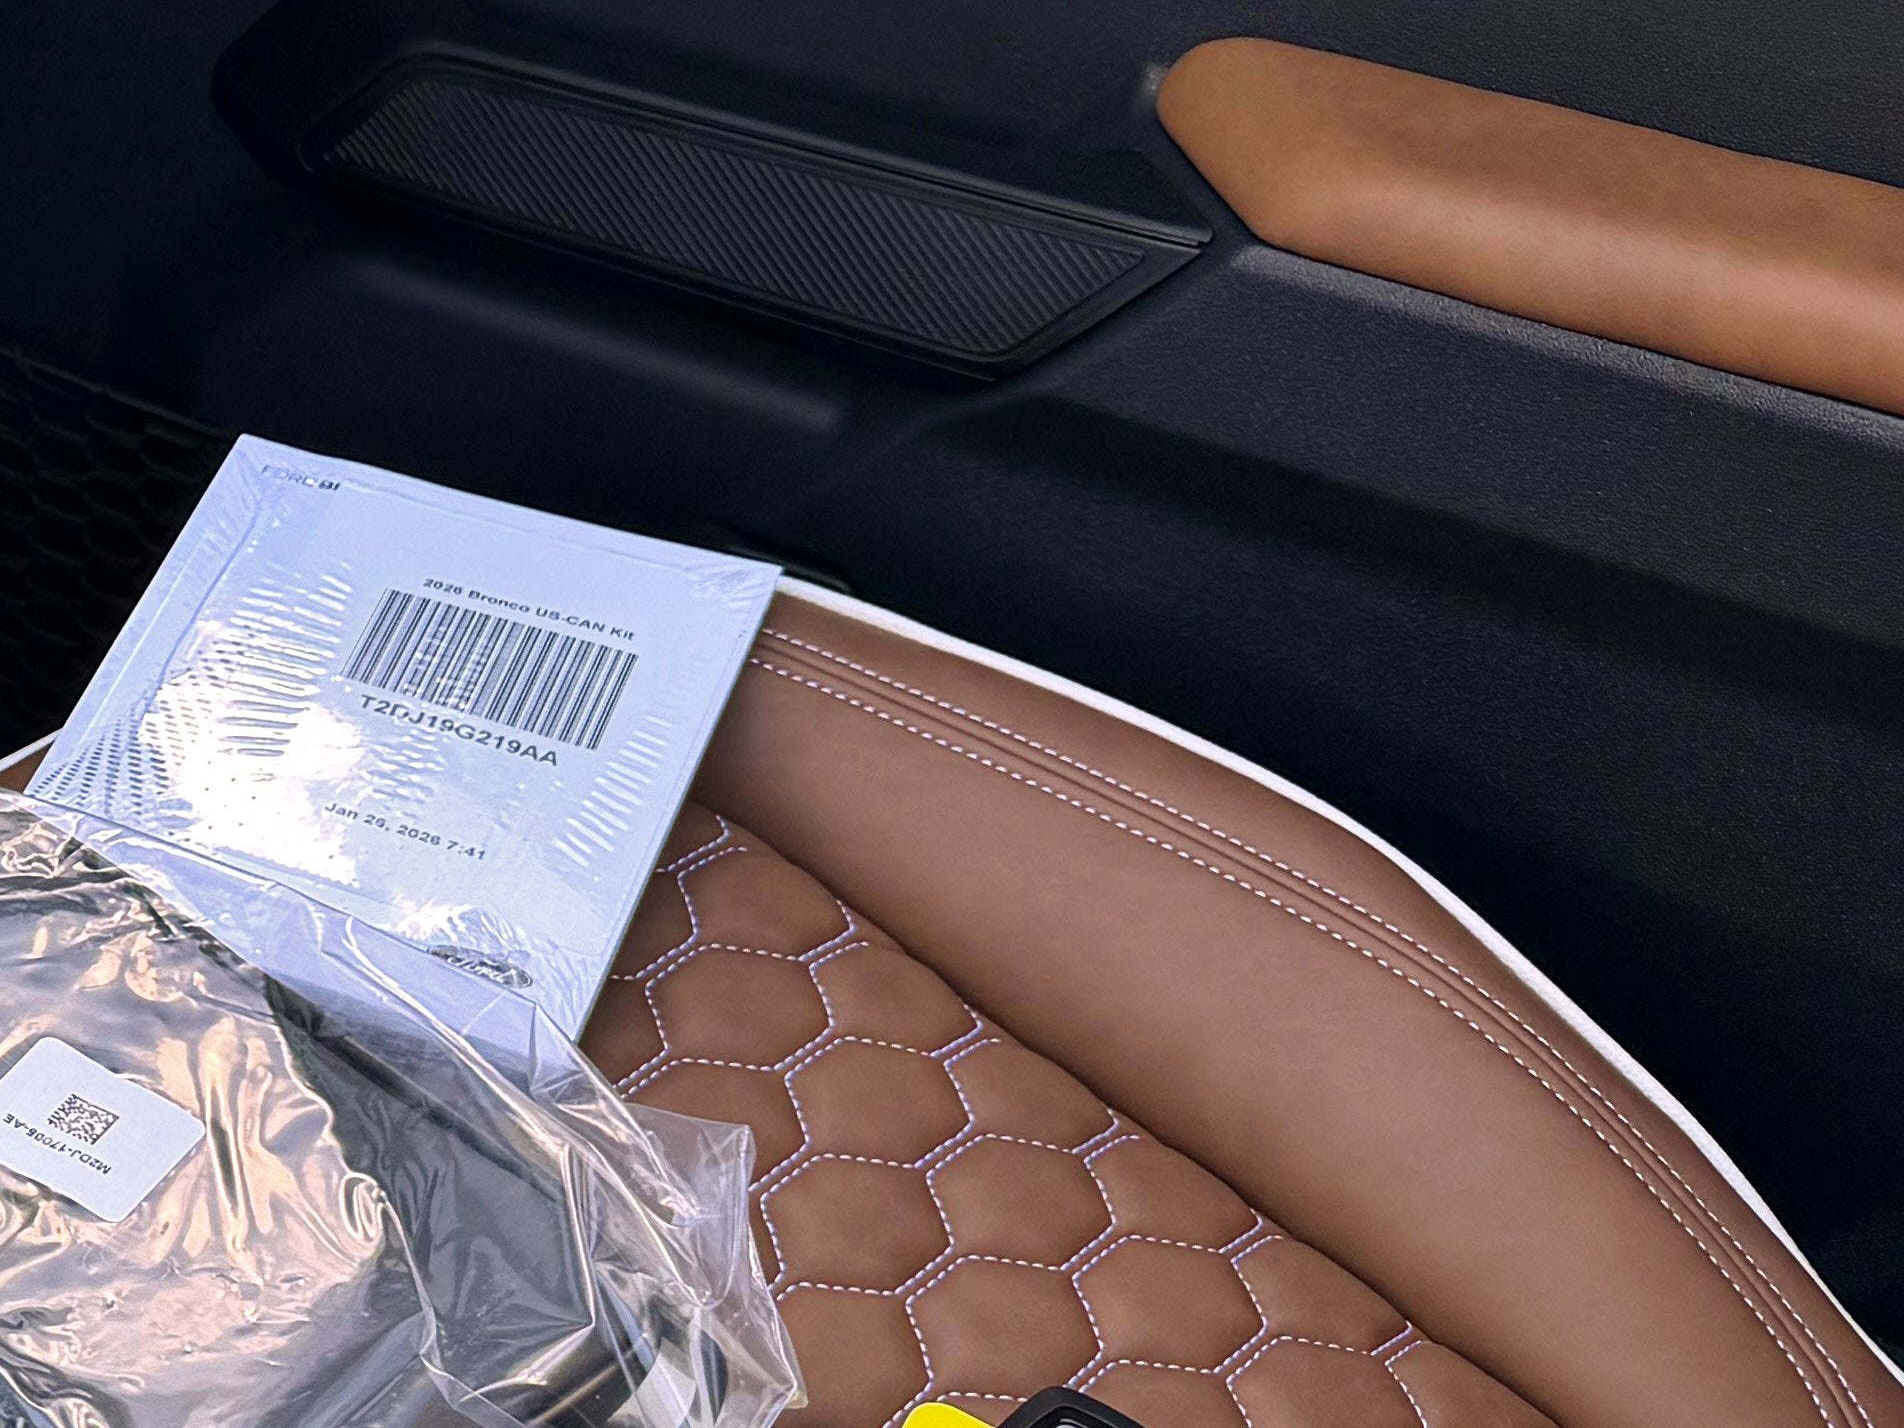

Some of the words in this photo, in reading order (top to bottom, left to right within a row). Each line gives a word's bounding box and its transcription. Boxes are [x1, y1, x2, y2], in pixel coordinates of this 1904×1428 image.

[468, 588, 530, 613] Bronco
[536, 606, 606, 633] US-CAN
[610, 626, 635, 641] Kit
[361, 694, 558, 766] T2DJ19G219AA
[324, 803, 359, 820] Jan
